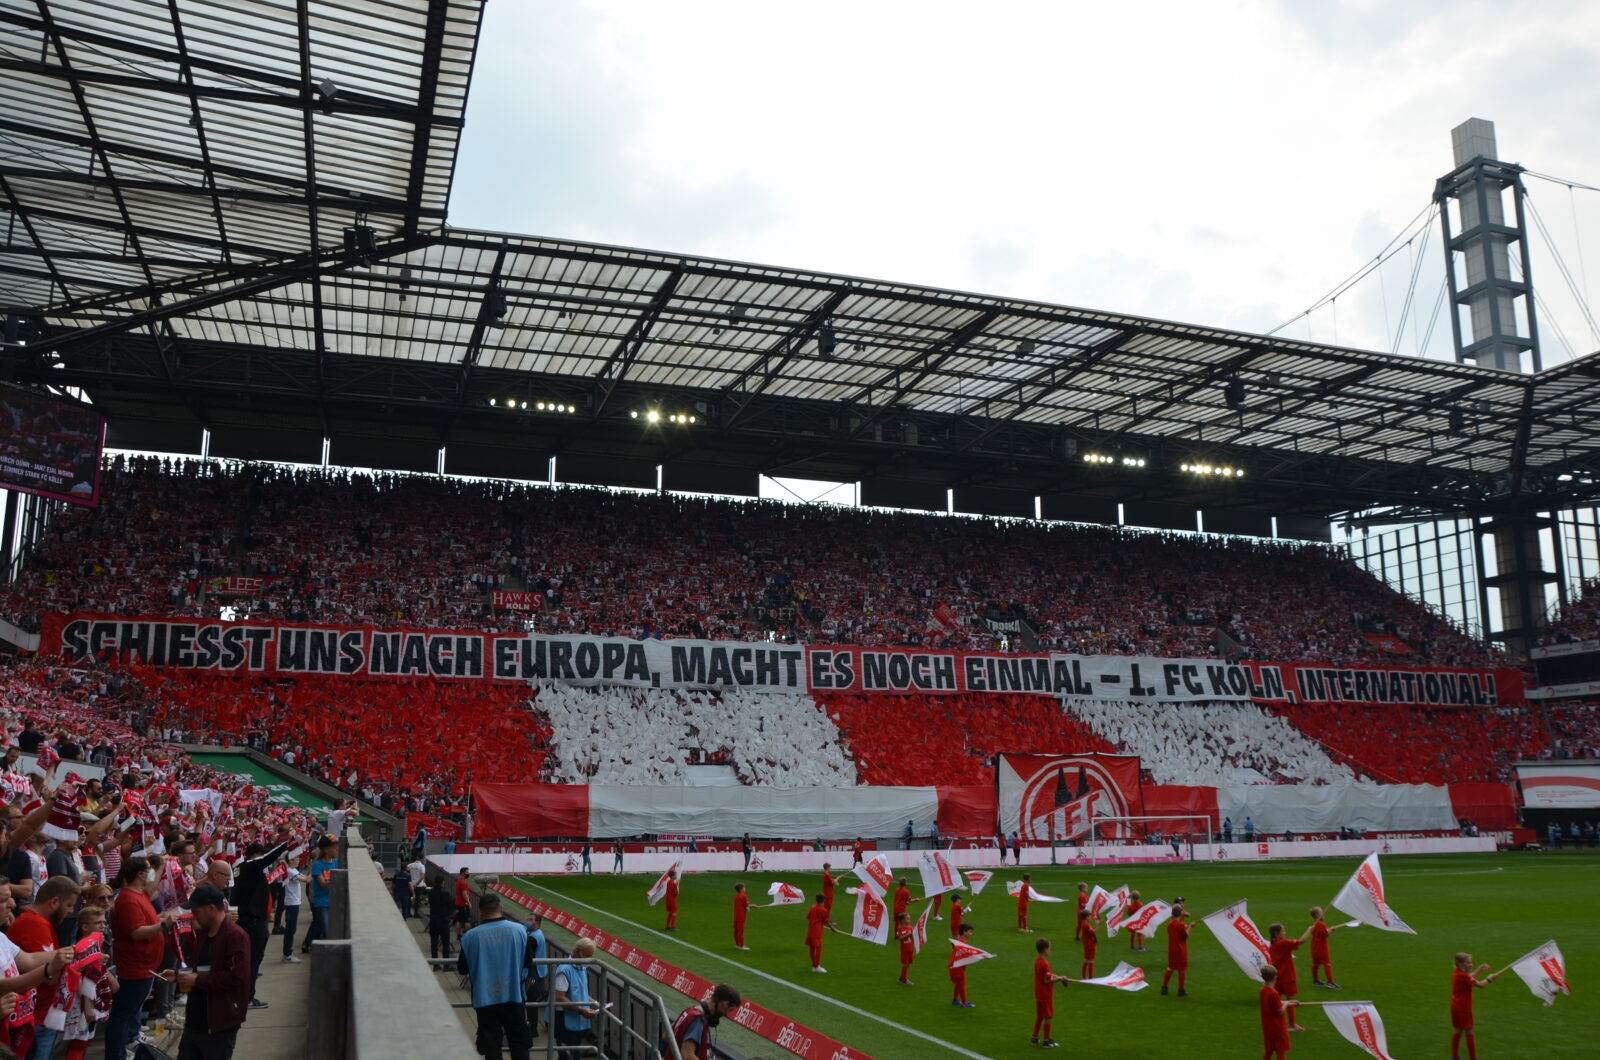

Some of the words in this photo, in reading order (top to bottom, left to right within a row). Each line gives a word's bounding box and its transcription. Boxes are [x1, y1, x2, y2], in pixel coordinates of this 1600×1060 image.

[493, 591, 541, 607] HAWKS
[505, 601, 530, 610] KÖLN
[985, 618, 1022, 633] TROIKA
[61, 618, 275, 671] SCHIESST
[278, 627, 366, 676] UNS
[370, 631, 485, 679] NACH
[493, 636, 661, 688] EUROPA,
[671, 644, 804, 689] MACHT
[810, 648, 857, 690] ES
[861, 651, 958, 692] NOCH
[964, 655, 1093, 696] EINMAL
[1128, 663, 1156, 697] 1.
[1165, 663, 1205, 697] FC
[1206, 659, 1297, 705] KÖLN,
[1296, 666, 1499, 706] INTERNATIONAL!
[733, 1001, 764, 1032] DERTOUR
[775, 1022, 812, 1057] DERTOUR
